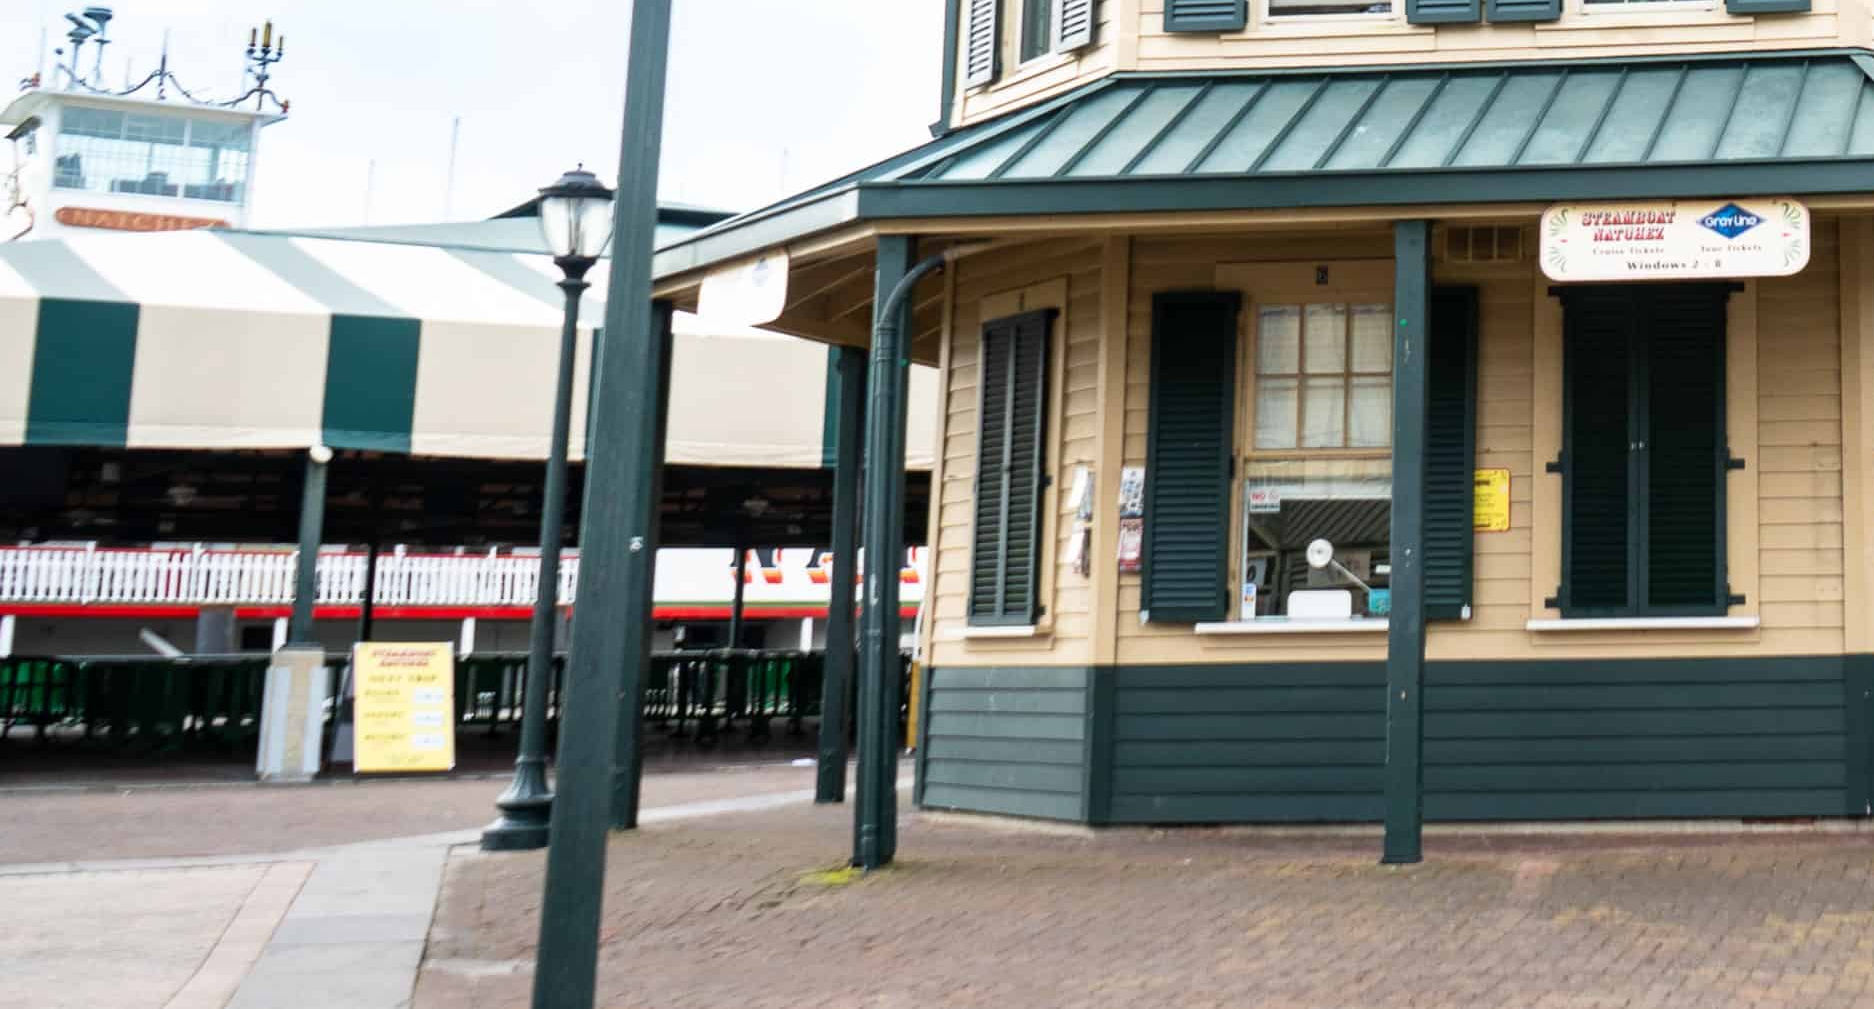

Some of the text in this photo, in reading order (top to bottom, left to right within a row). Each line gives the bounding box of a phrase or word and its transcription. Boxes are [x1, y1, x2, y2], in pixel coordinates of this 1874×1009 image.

[1581, 210, 1676, 226] STEAMBOAT
[1593, 227, 1665, 242] NATCHEZ
[1629, 246, 1665, 255] Tickets
[1727, 244, 1762, 253] Tickets
[1626, 260, 1687, 271] Windows
